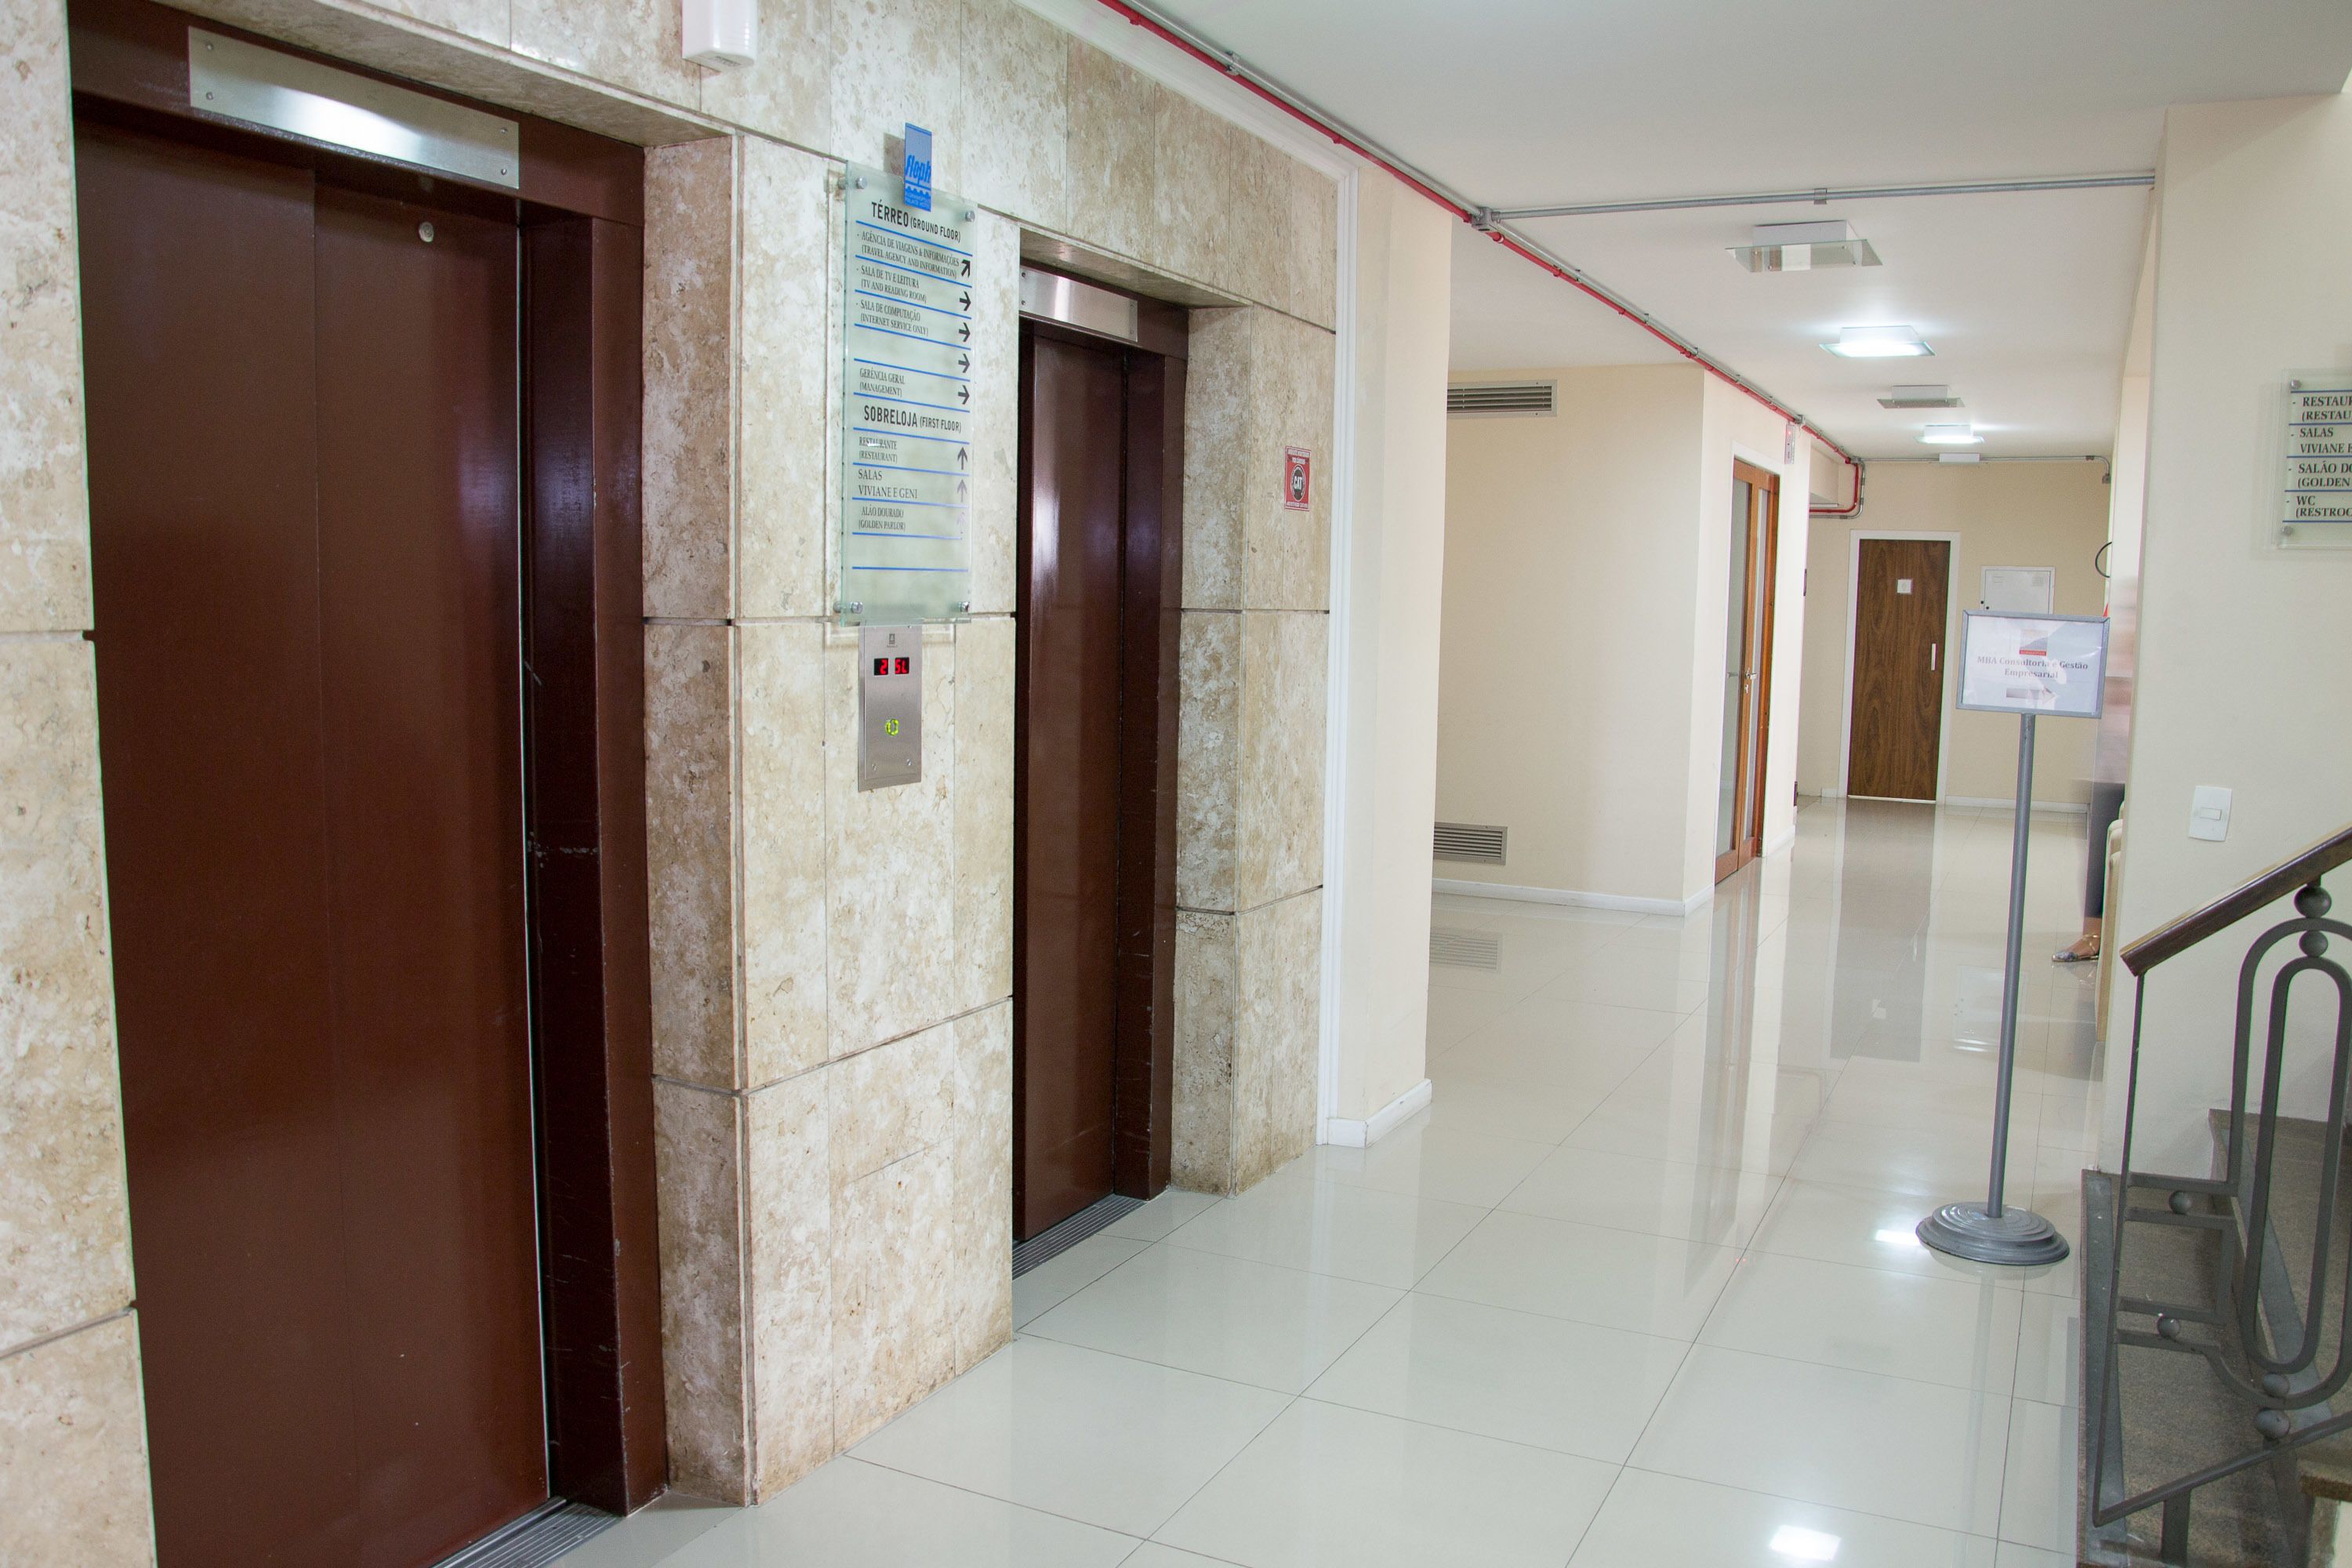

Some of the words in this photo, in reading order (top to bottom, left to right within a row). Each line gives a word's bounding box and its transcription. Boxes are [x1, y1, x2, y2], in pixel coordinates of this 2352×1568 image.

[872, 199, 909, 227] TÉRREO
[910, 217, 938, 235] (GROUND
[940, 226, 960, 243] FLOOR)
[887, 238, 895, 249] DE
[895, 240, 918, 256] VIAGENS
[862, 245, 884, 258] (TRAVEL
[885, 251, 906, 264] AGENCY
[908, 256, 919, 267] AND
[920, 261, 957, 279] INFORMATION)
[861, 265, 876, 278] SALA
[877, 269, 884, 279] DE
[884, 270, 892, 281] TV
[892, 273, 897, 283] E
[897, 274, 920, 289] LEITURA
[861, 278, 870, 289] (TV
[871, 281, 884, 292] AND
[884, 284, 908, 298] READING
[909, 291, 927, 304] ROOM)
[861, 299, 874, 311] SALA
[876, 303, 884, 313] DE
[884, 305, 921, 322] COMPUTAÇÃO
[861, 313, 890, 326] (INTERNET
[891, 320, 912, 332] SERVICE
[913, 324, 929, 337] ONLY)
[888, 372, 906, 385] GERAL
[859, 382, 902, 397] (MANAGEMENT)
[864, 405, 917, 427] SOBRELOJA
[920, 416, 939, 430] (FIRST
[941, 419, 961, 434] FLOOR)
[2299, 426, 2334, 437] SALAS
[2300, 443, 2344, 453] VIVIANE
[859, 450, 898, 463] (RESTAURANT)
[858, 468, 883, 481] SALAS
[2298, 477, 2350, 488] (GOLDEN
[858, 485, 891, 498] VIVIANE
[893, 487, 898, 498] E
[898, 488, 917, 499] GENI
[2296, 495, 2316, 506] WC
[877, 507, 904, 518] DOURADO
[858, 519, 884, 530] (GOLDEN
[884, 521, 906, 532] PARLOR)
[880, 659, 887, 674] 2
[1977, 655, 1997, 665] MBA
[2060, 660, 2089, 670] Gestão
